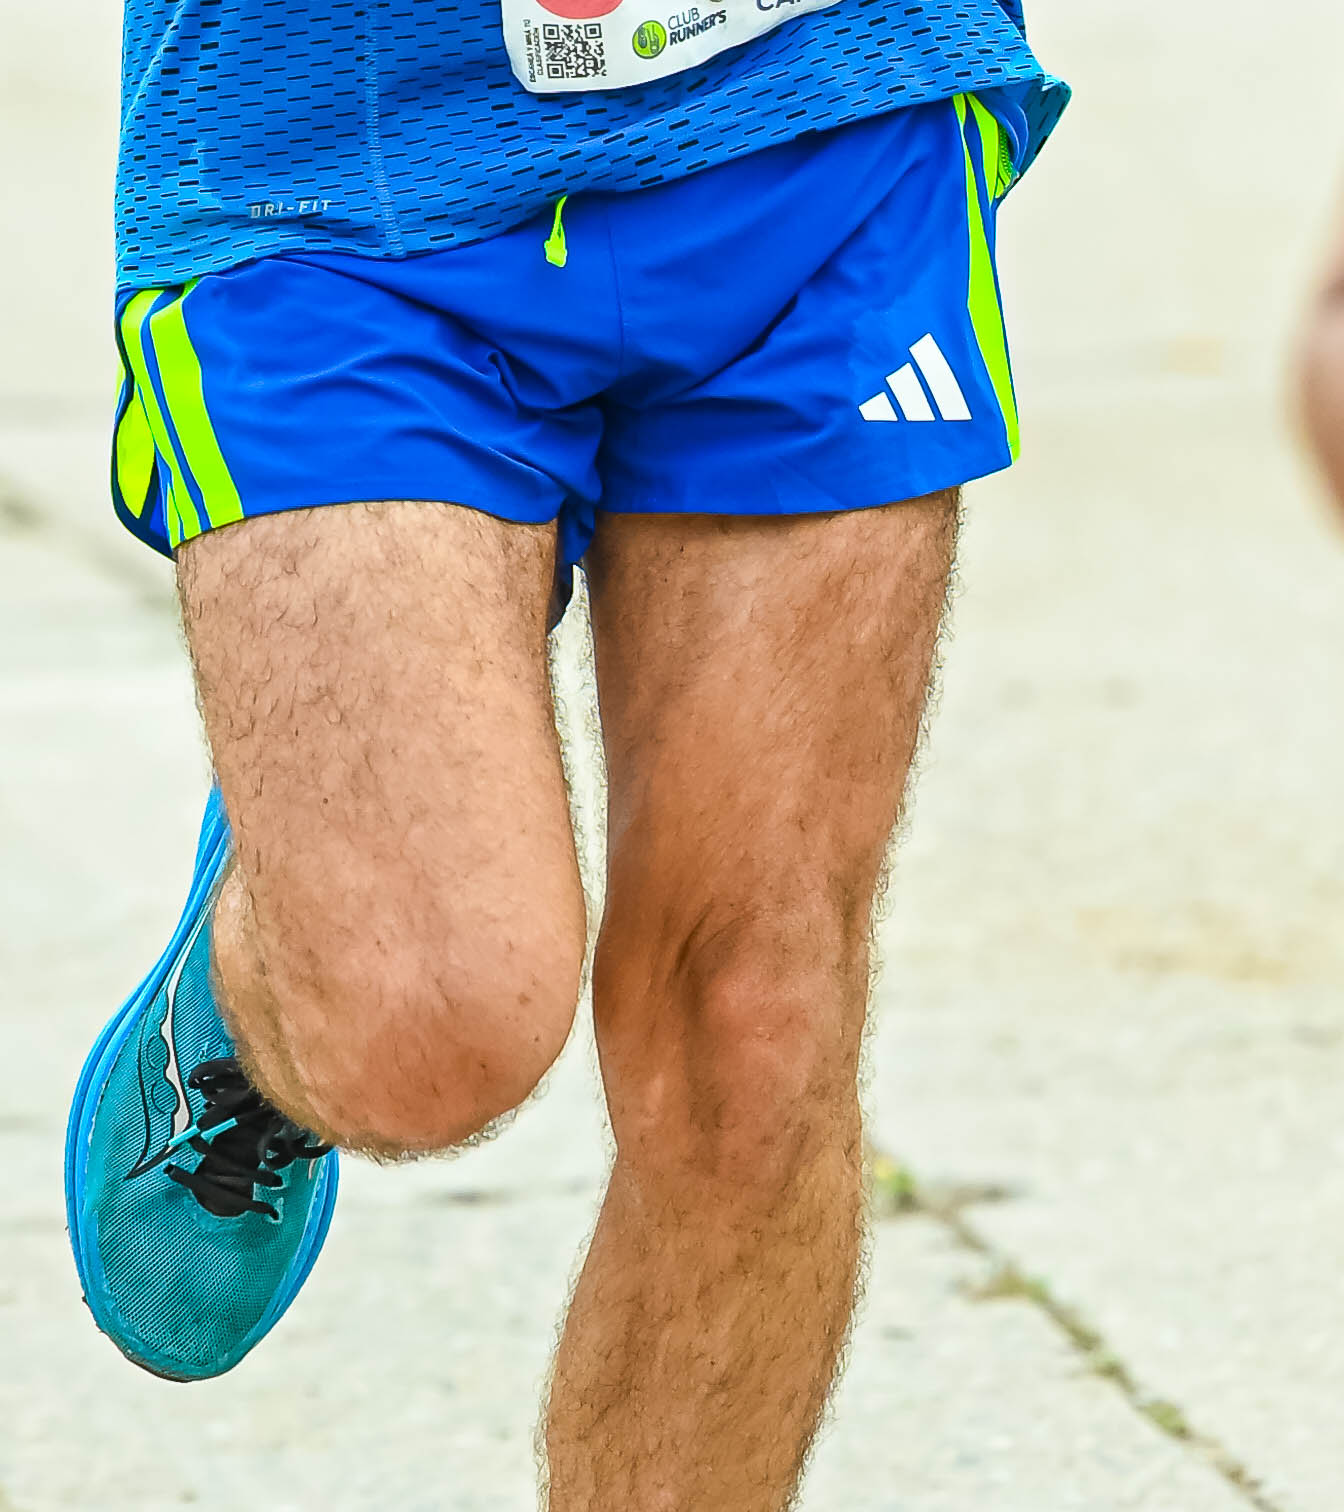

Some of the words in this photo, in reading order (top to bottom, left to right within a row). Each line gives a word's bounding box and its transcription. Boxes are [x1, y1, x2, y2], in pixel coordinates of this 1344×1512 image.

[668, 8, 700, 30] CLUB
[669, 10, 727, 46] RUNNER'S
[250, 199, 332, 219] DRI-FIT
